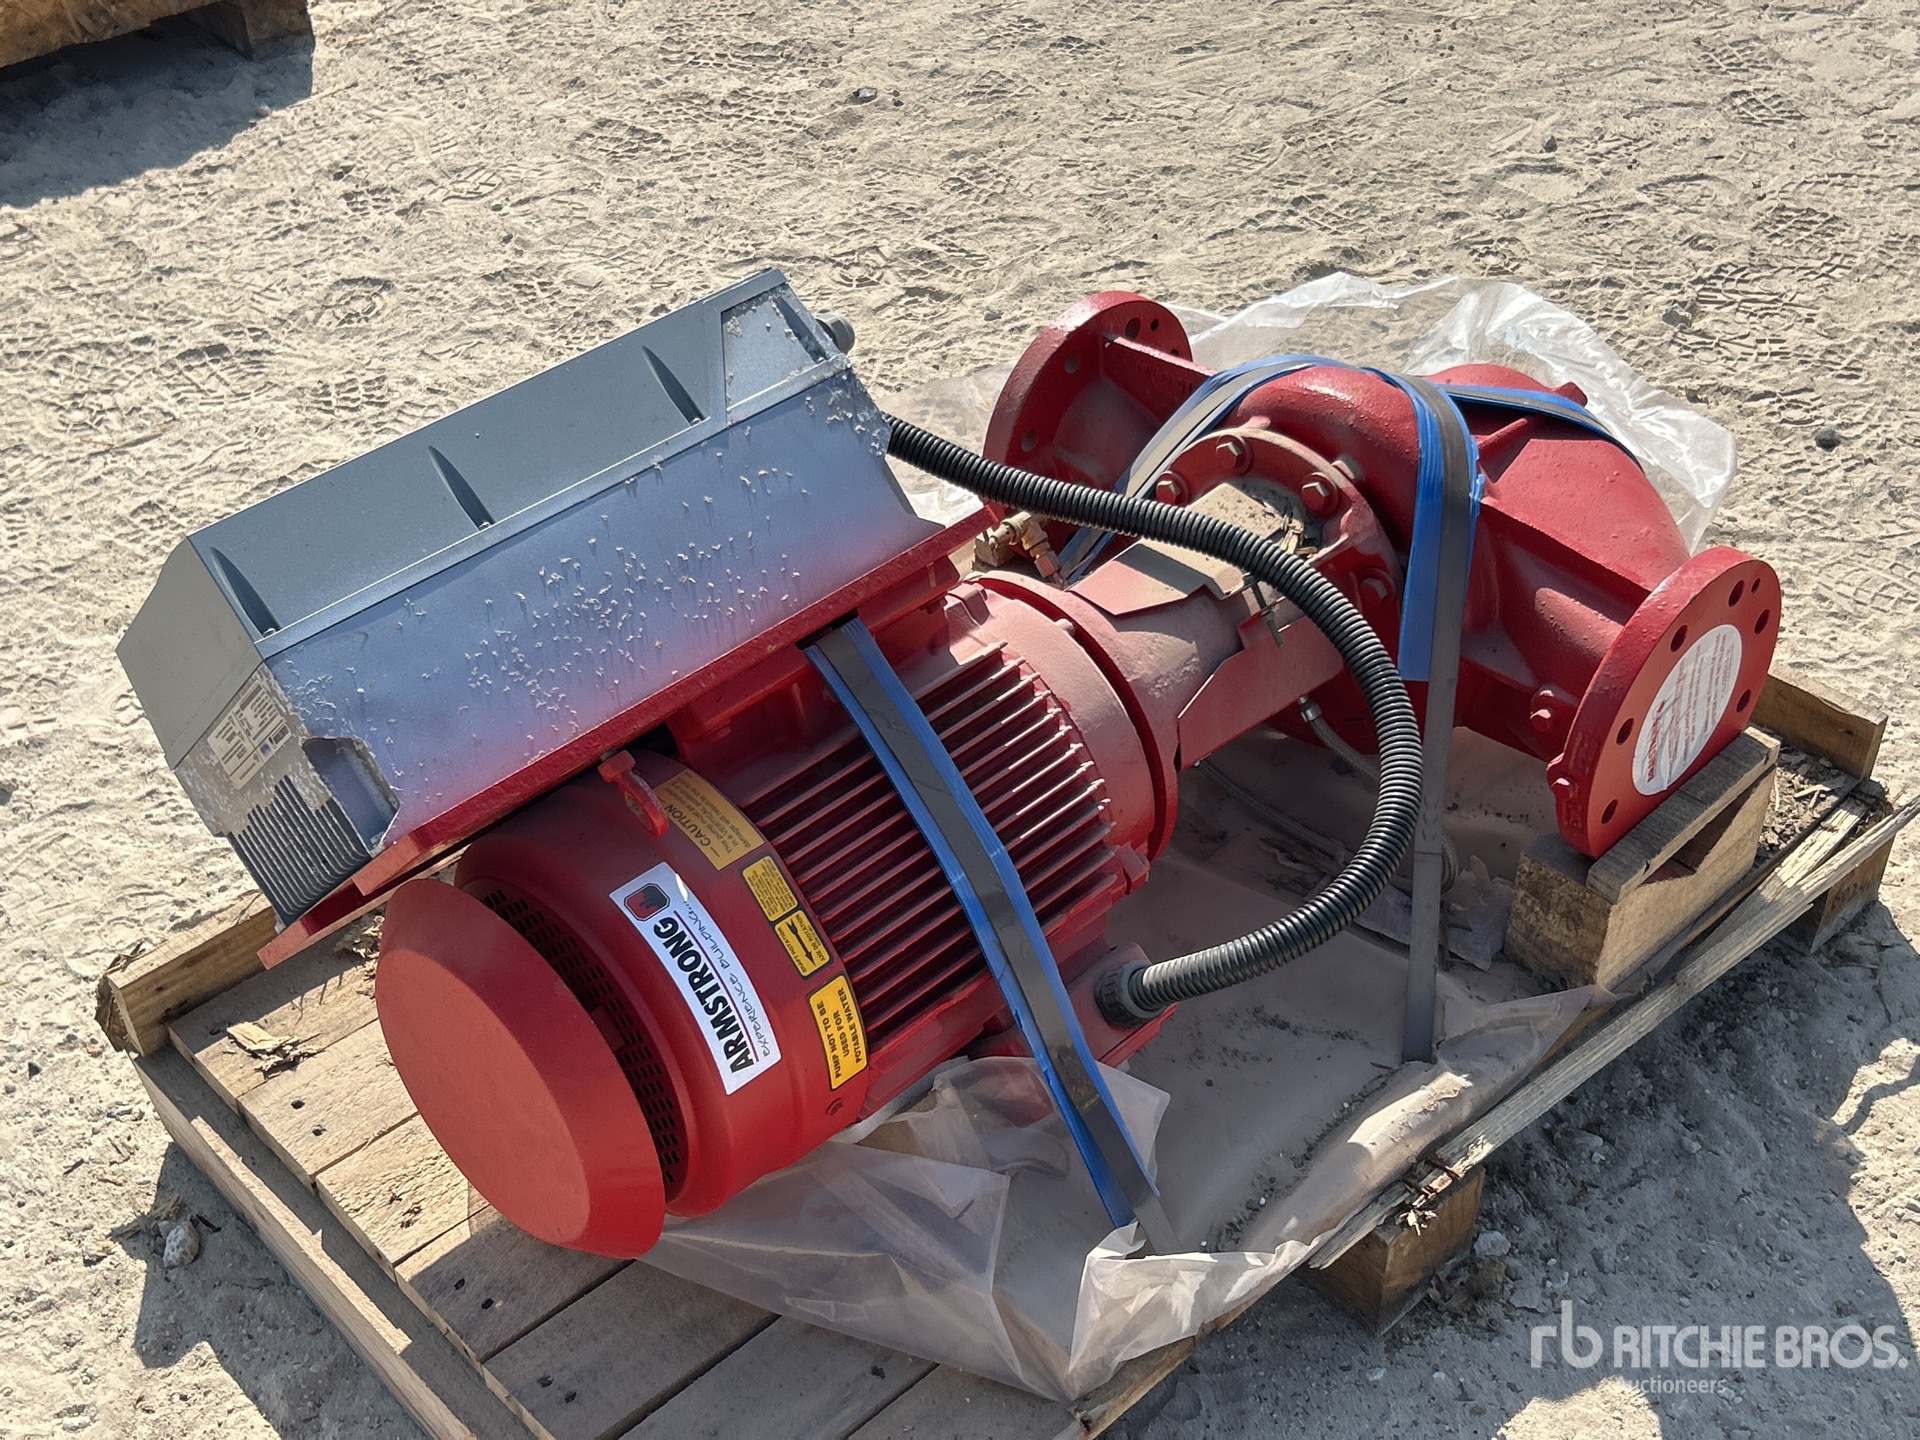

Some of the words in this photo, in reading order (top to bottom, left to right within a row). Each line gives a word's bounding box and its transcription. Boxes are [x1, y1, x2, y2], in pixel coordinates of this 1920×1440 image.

[664, 804, 711, 846] CAUTION
[697, 805, 728, 835] VERTICAL
[777, 926, 795, 955] ROTATION
[795, 913, 813, 941] ROTATION
[793, 954, 806, 973] SHAFT
[654, 917, 754, 1073] ARMSTRONG
[816, 1000, 826, 1016] BE
[837, 987, 853, 1022] WATER
[822, 1017, 831, 1032] TO
[833, 1010, 844, 1031] FOR
[827, 1033, 837, 1052] NOT
[840, 1031, 849, 1057] USED
[849, 1022, 862, 1064] POTABLE
[832, 1054, 842, 1079] PUMP
